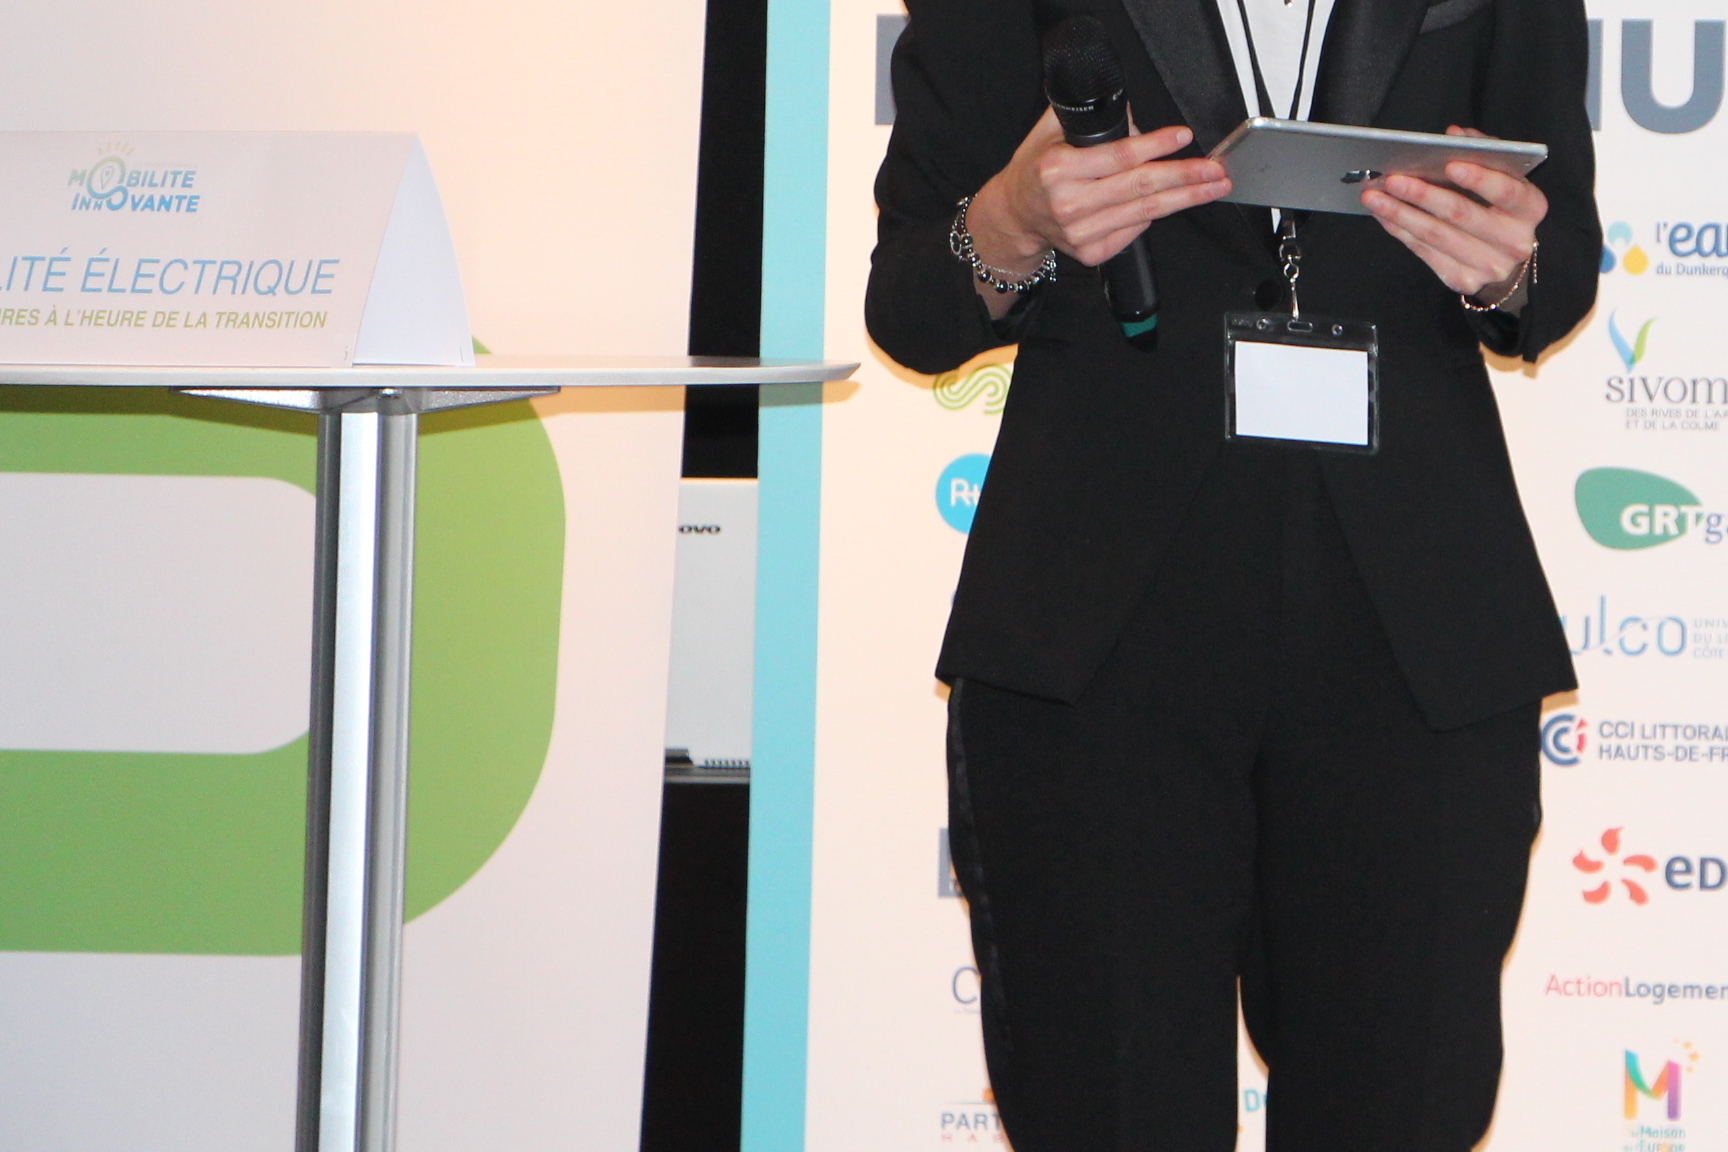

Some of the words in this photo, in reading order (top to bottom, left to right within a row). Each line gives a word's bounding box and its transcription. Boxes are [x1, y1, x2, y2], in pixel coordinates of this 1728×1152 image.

[0, 246, 72, 292] ITÉ
[80, 247, 341, 297] ÉLECTRIQUE
[1655, 260, 1672, 276] du
[0, 308, 42, 327] RES
[44, 304, 58, 327] À
[63, 308, 149, 328] L'HEURE
[151, 310, 180, 329] DE
[183, 310, 208, 329] LA
[215, 310, 328, 329] TRANSITION
[1625, 407, 1648, 419] DES
[1650, 407, 1683, 419] RIVES
[1685, 407, 1701, 419] DE
[1625, 419, 1640, 431] ET
[1643, 420, 1659, 431] DE
[1661, 420, 1679, 431] LA
[1680, 420, 1720, 432] COLME
[1693, 633, 1712, 645] DU
[1599, 720, 1635, 739] CCI
